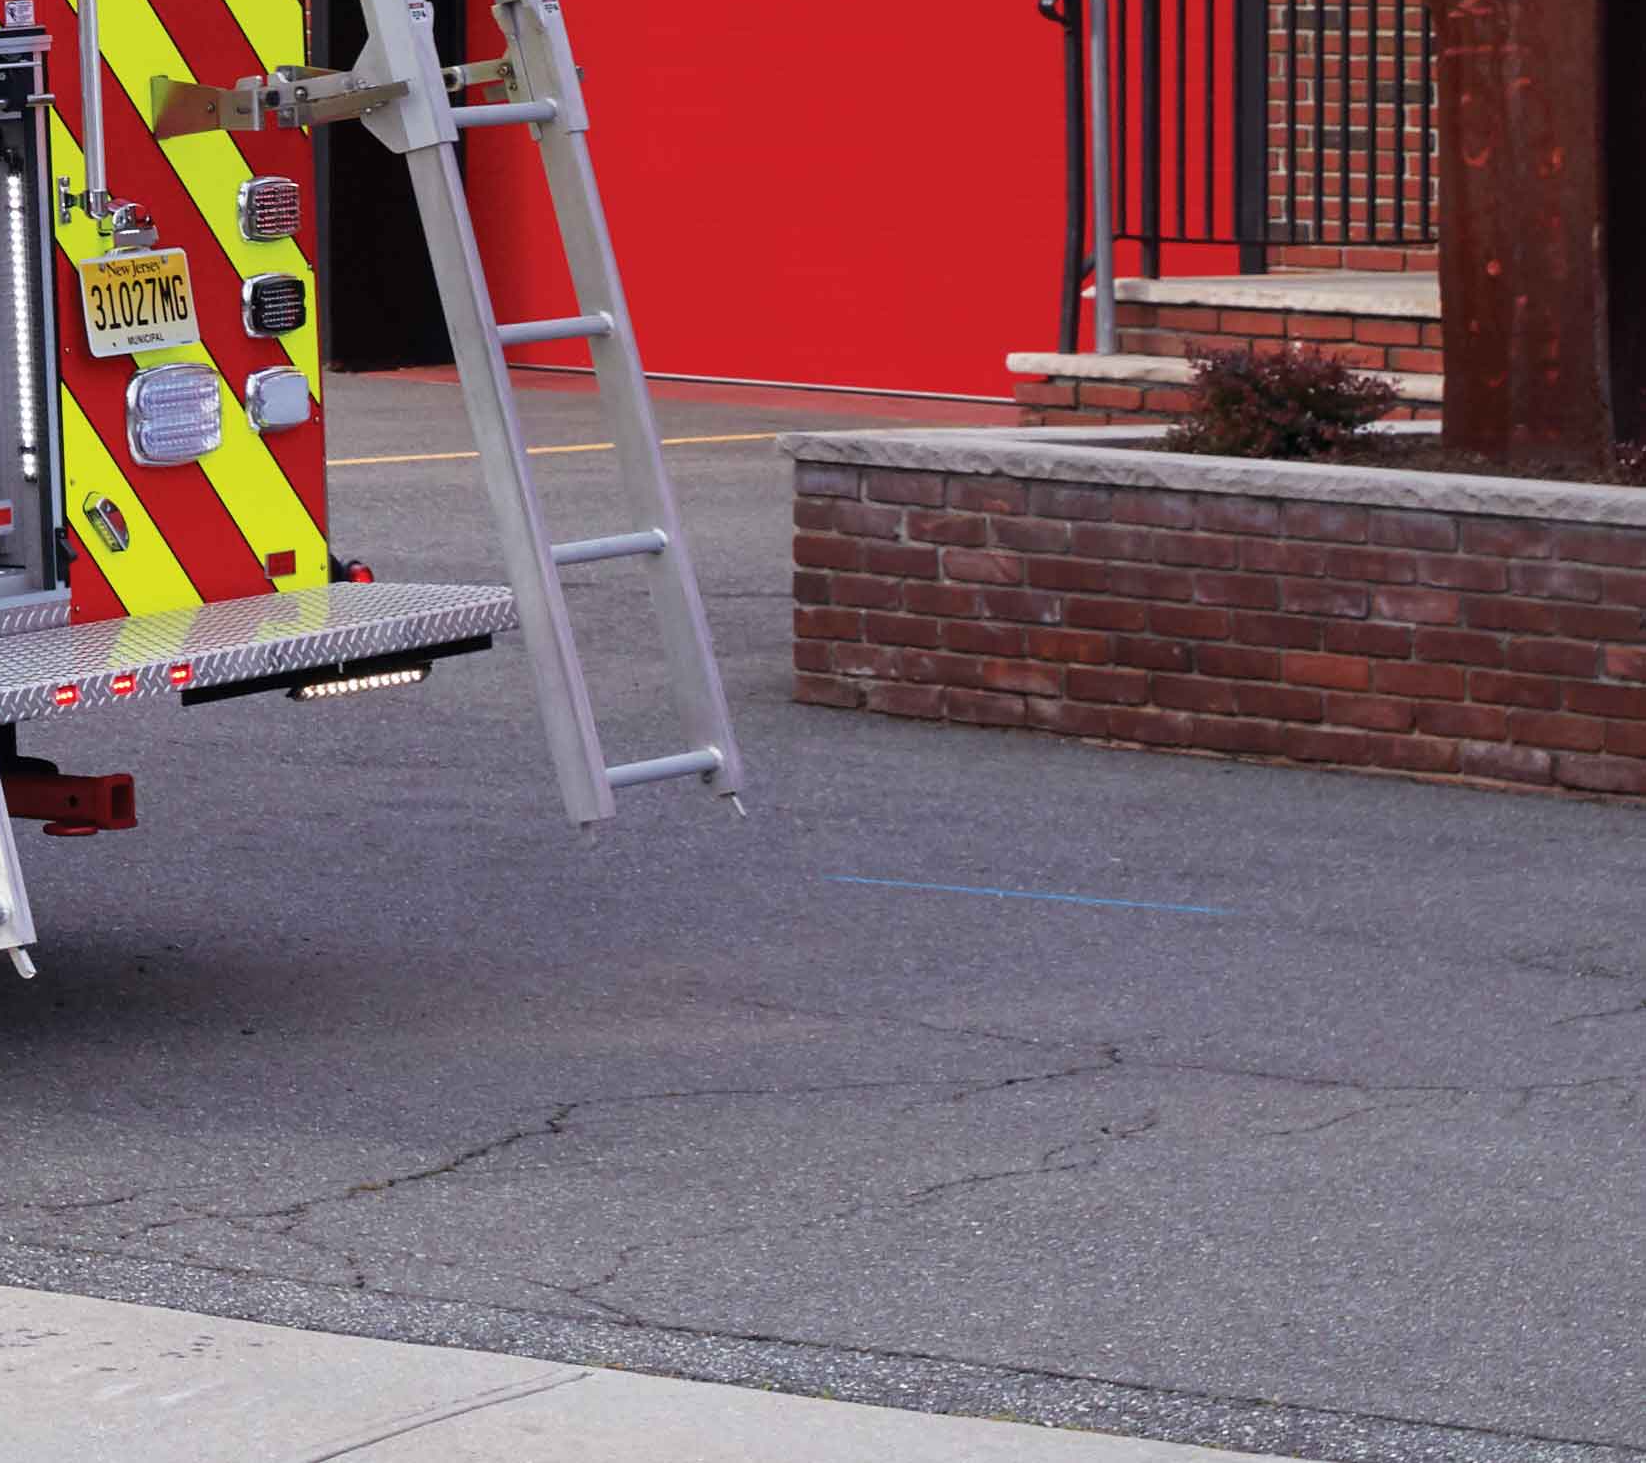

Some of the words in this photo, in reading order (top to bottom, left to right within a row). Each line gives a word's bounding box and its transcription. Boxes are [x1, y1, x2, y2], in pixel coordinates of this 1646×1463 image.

[104, 262, 130, 277] New
[132, 259, 162, 277] Jersey
[91, 275, 188, 331] 31027MG
[127, 332, 165, 345] MUNICIPAL
